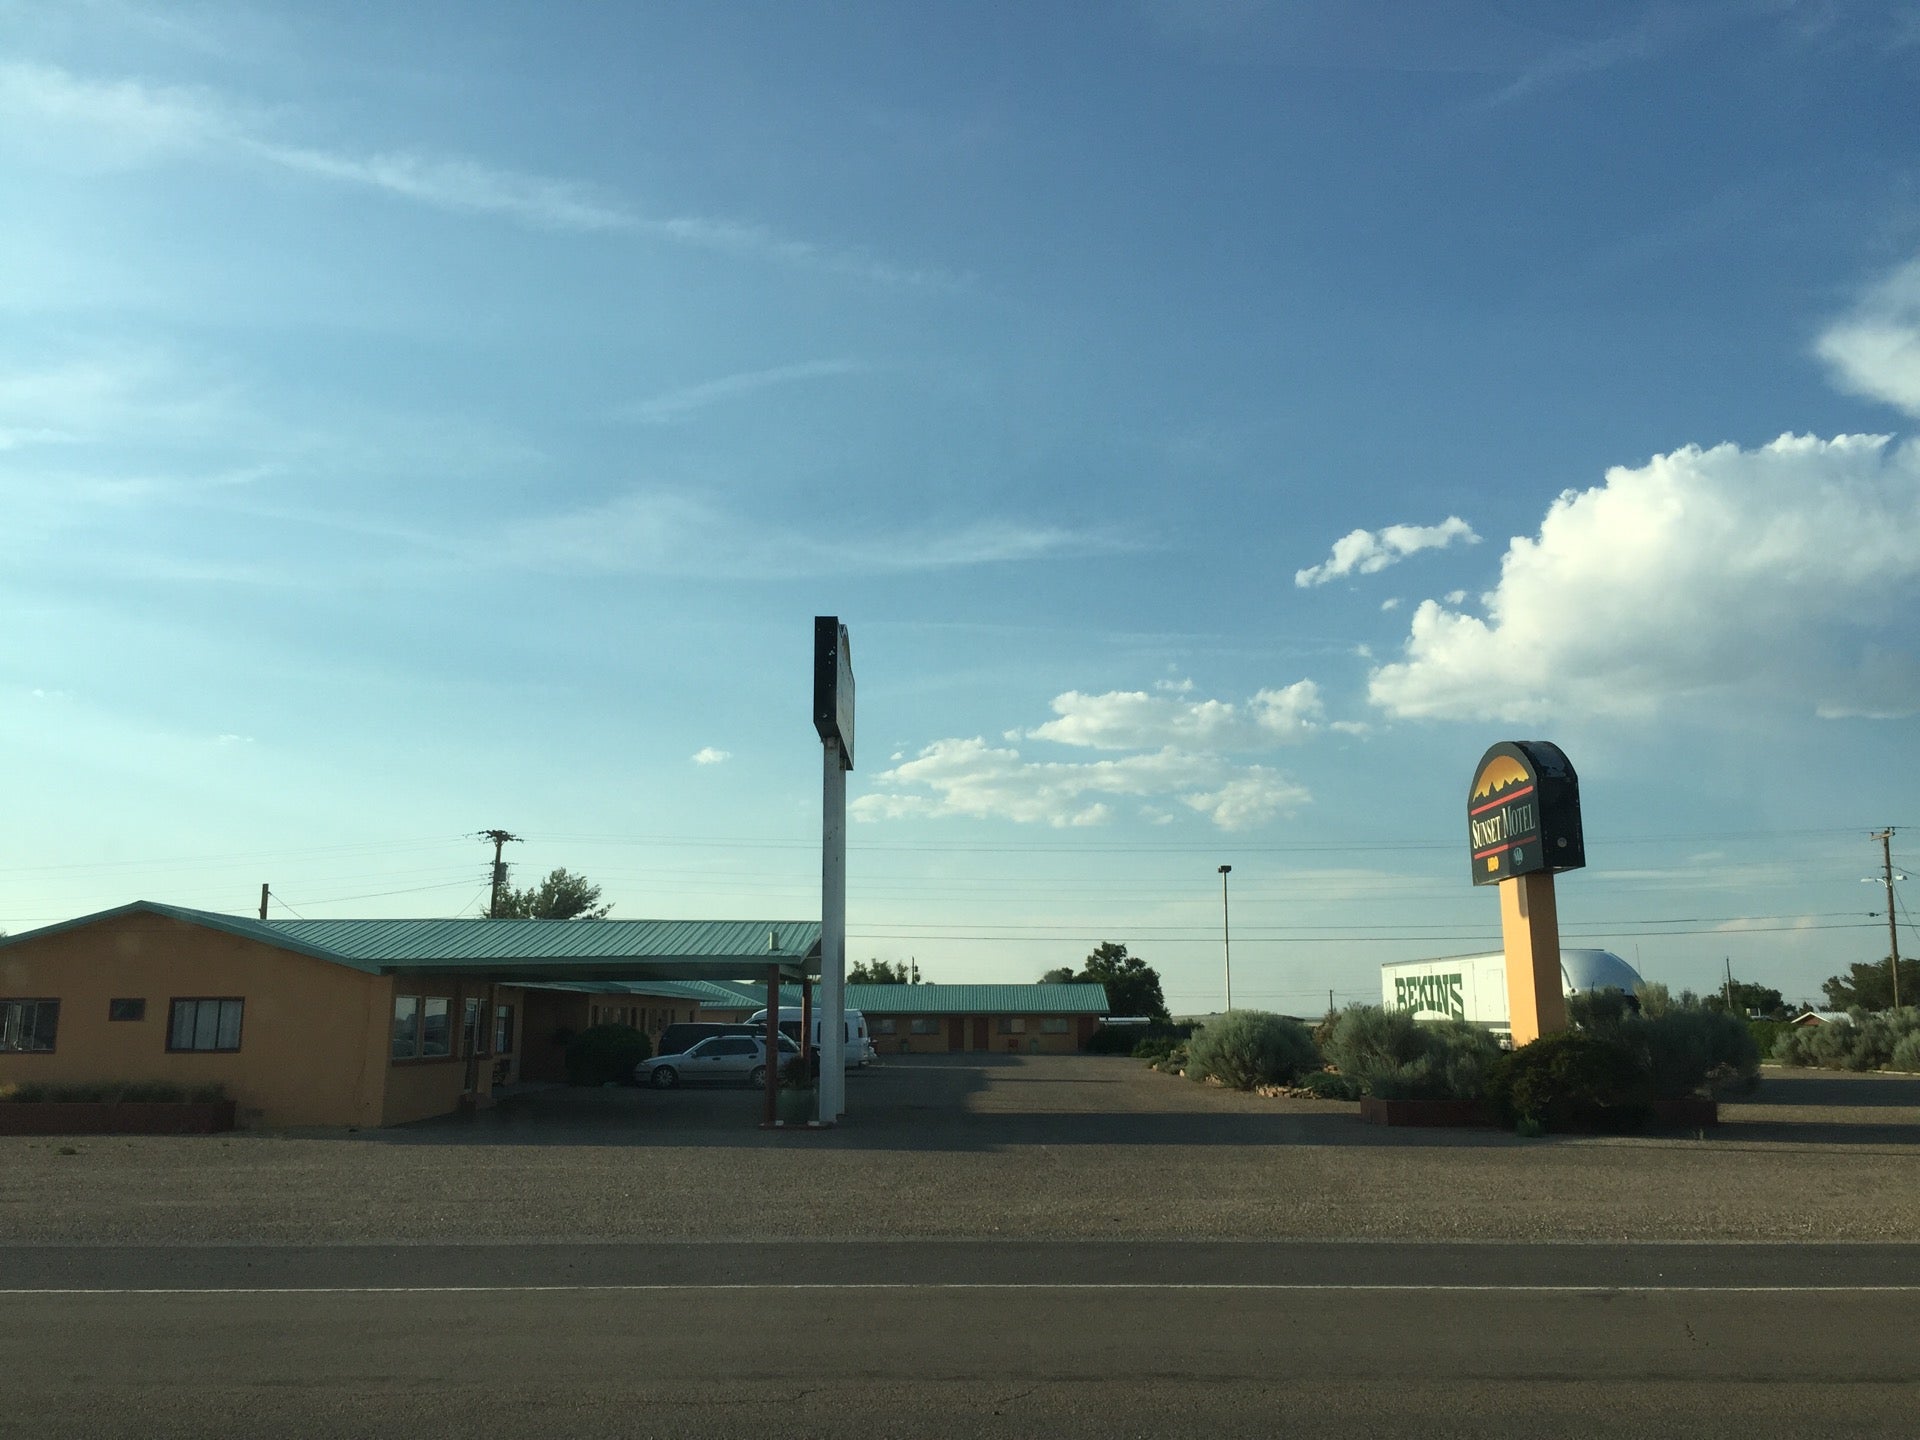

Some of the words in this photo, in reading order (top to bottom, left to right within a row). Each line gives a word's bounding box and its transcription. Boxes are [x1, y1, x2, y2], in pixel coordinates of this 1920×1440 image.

[1472, 815, 1501, 849] SUNSET
[1502, 804, 1535, 839] MOTEL
[1395, 973, 1465, 1023] BEKINS
